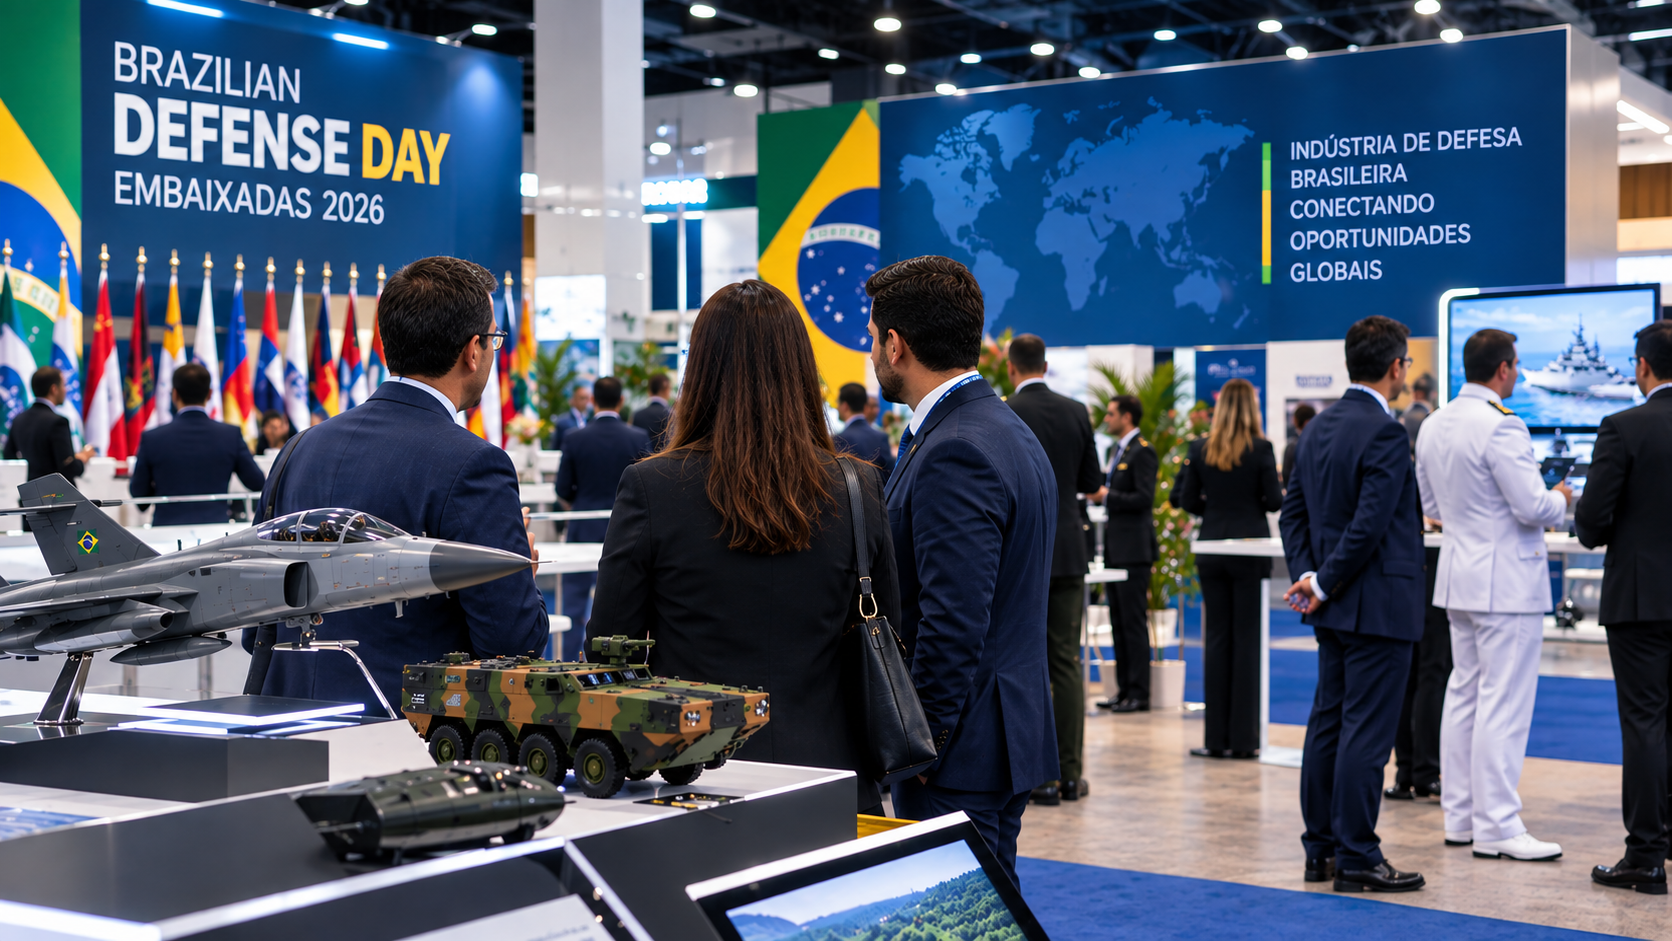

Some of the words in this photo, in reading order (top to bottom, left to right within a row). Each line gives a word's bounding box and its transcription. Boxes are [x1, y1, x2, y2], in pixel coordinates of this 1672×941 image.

[114, 41, 300, 104] BRAZILIAN
[114, 92, 350, 177] DEFENSE
[361, 122, 451, 186] DAY
[1290, 133, 1397, 160] INDÚSTRIA
[1403, 132, 1431, 153] DE
[1437, 126, 1523, 151] DEFESA
[1290, 163, 1408, 189] BRASILEIRA
[114, 170, 312, 219] EMBAIXADAS
[322, 189, 385, 225] 2026
[1290, 193, 1435, 220] CONECTANDO
[1290, 223, 1471, 251] OPORTUNIDADES
[1290, 259, 1383, 283] GLOBAIS
